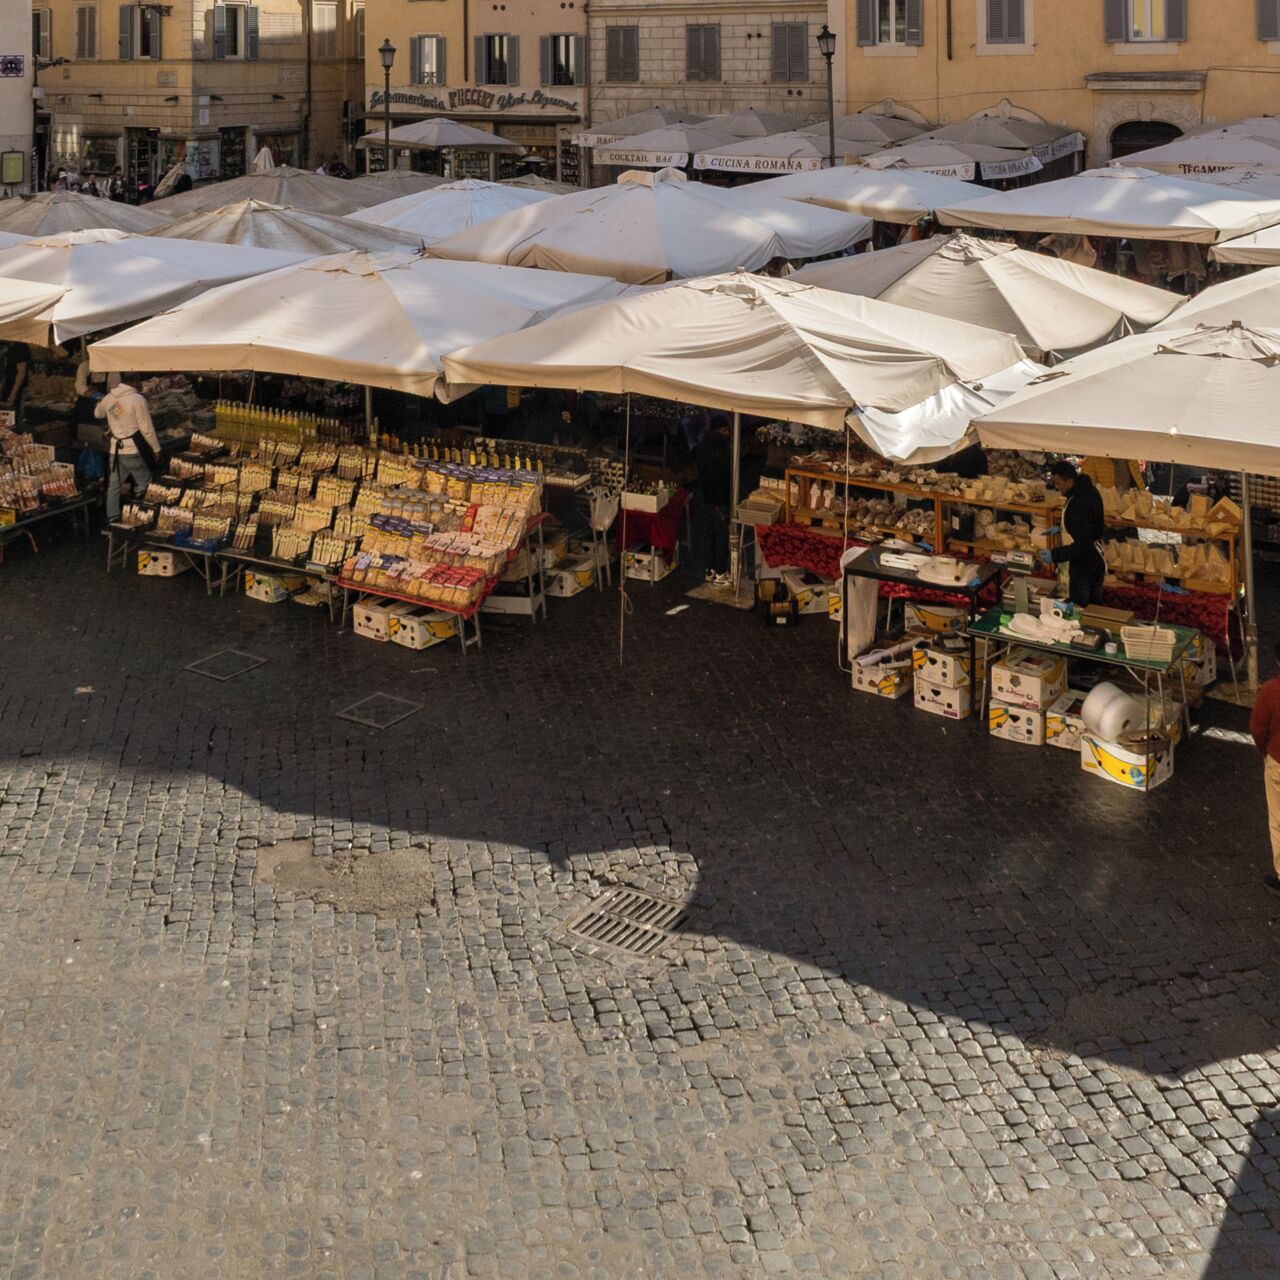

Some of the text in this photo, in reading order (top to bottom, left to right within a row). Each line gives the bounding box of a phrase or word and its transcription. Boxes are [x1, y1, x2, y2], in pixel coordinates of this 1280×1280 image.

[609, 152, 649, 163] COCKTAIL
[710, 158, 803, 170] CUCINA ROMANA
[1178, 163, 1235, 175] TEGAMIN
